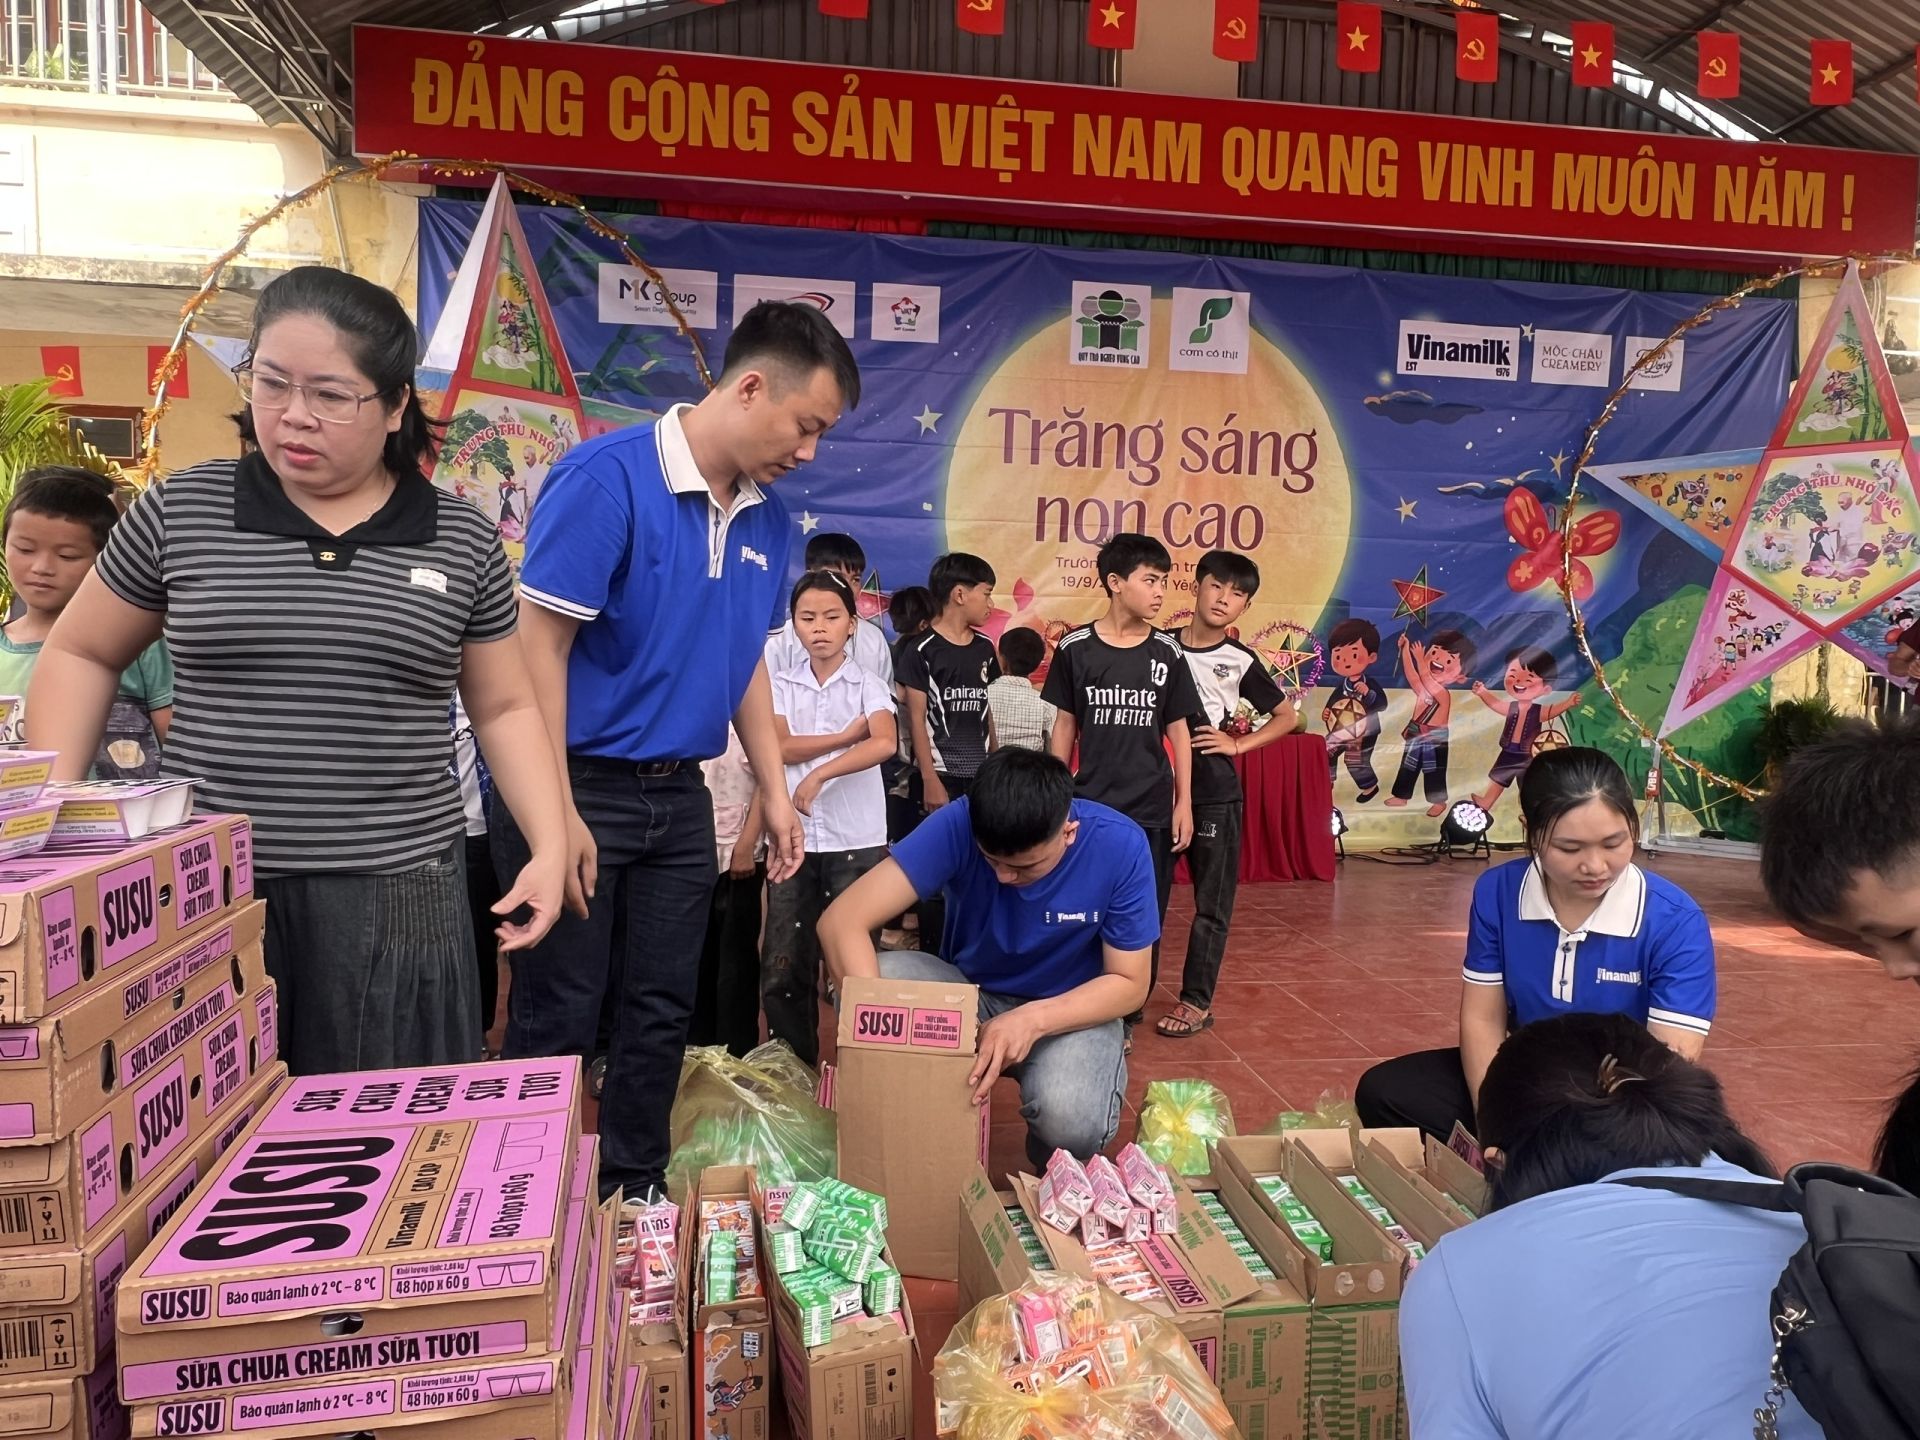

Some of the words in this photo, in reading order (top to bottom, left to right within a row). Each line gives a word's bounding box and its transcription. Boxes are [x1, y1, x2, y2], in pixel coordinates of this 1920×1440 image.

[412, 41, 583, 137] ĐẢNG
[609, 66, 770, 157] CỘNG
[792, 74, 912, 162] SẢN
[936, 95, 1054, 182] VIỆT
[1072, 114, 1201, 184] NAM
[1222, 127, 1398, 198] QUANG
[1418, 141, 1533, 207] VINH
[1552, 145, 1694, 220] MUÔN
[1713, 156, 1824, 229] NĂM
[654, 291, 697, 307] goup
[1407, 334, 1510, 366] Vinamilk
[1541, 358, 1602, 371] CREAMERY
[1406, 361, 1417, 371] EST
[453, 425, 496, 468] TRUNG
[498, 422, 525, 436] THU
[529, 429, 556, 452] NHỚ
[988, 405, 1163, 486] Trăng
[1179, 413, 1317, 493] sáng
[1765, 483, 1806, 523] TRUNG
[1810, 474, 1843, 490] THU
[1846, 475, 1878, 496] NHỚ
[1875, 488, 1902, 519] BÁC
[1036, 496, 1146, 543] non
[1162, 501, 1264, 550] cao
[1094, 709, 1110, 725] FLY
[1114, 709, 1153, 726] BETTER
[180, 848, 195, 871] SỮA
[195, 841, 211, 866] CHUA
[187, 867, 209, 894] CREAM
[103, 876, 151, 947] SUSU
[184, 899, 198, 922] SỮA
[125, 977, 149, 1016] SUSU
[858, 1011, 904, 1037] SUSU
[130, 1051, 147, 1078] SỮA
[149, 1038, 169, 1065] CHUA
[170, 1015, 195, 1047] CREAM
[208, 1038, 222, 1059] SỮA
[222, 1020, 238, 1049] CHUA
[215, 1046, 237, 1079] CREAM
[212, 1081, 225, 1106] SỮA
[293, 1088, 347, 1113] SỮA
[348, 1082, 404, 1114] CHUA
[405, 1074, 460, 1115] CREAM
[464, 1077, 509, 1102] SỮA
[139, 1074, 184, 1159] SUSU
[411, 1176, 437, 1192] CAO
[500, 1181, 529, 1194] 60
[509, 1173, 534, 1181] g
[179, 1137, 395, 1261] SUSU
[492, 1203, 528, 1225] hộp
[385, 1200, 428, 1249] Vinamilk
[489, 1224, 521, 1238] 48
[226, 1290, 248, 1306] Bảo
[249, 1286, 281, 1303] quản
[282, 1283, 308, 1300] lạnh
[311, 1282, 319, 1296] ở
[396, 1280, 410, 1294] 48
[413, 1279, 434, 1294] hộp
[436, 1279, 443, 1290] x
[446, 1275, 460, 1289] 60
[462, 1276, 470, 1290] g
[1167, 1279, 1204, 1304] SUSU
[145, 1288, 206, 1322] SUSU
[175, 1362, 221, 1391] SỮA
[228, 1352, 290, 1384] CHUA
[295, 1344, 372, 1376] CREAM
[378, 1335, 421, 1367] SỮA
[425, 1330, 480, 1359] TƯƠI
[240, 1403, 262, 1419] Bảo
[264, 1400, 293, 1418] quản
[295, 1397, 320, 1413] lạnh
[322, 1395, 331, 1410] ở
[407, 1392, 421, 1407] 48
[423, 1391, 445, 1406] hộp
[447, 1391, 454, 1403] x
[456, 1387, 470, 1401] 60
[472, 1388, 480, 1402] g
[160, 1403, 221, 1435] SUSU
